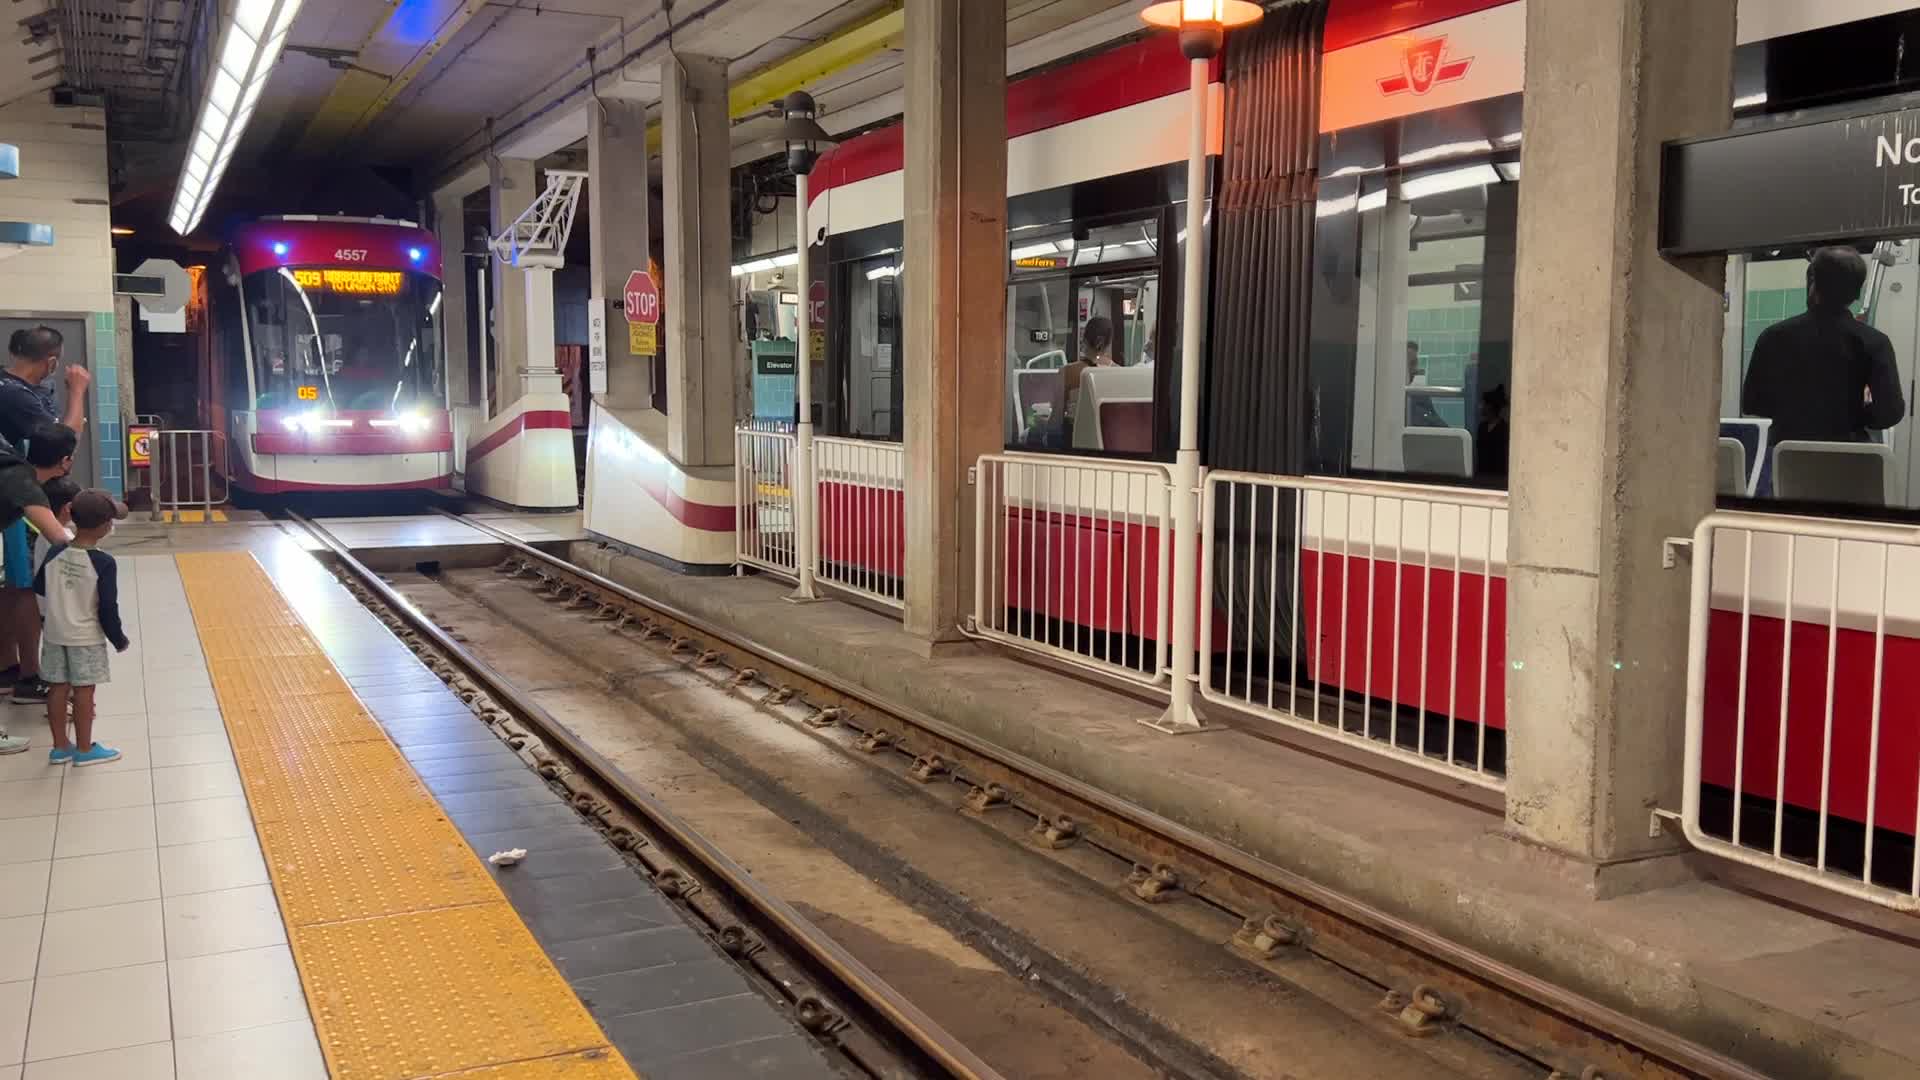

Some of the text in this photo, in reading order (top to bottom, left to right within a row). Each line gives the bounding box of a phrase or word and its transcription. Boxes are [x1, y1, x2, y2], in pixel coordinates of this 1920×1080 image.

[334, 249, 368, 261] 4557
[294, 271, 322, 287] 509
[626, 291, 656, 317] STOP
[766, 361, 793, 369] Elevator
[297, 385, 318, 400] 05
